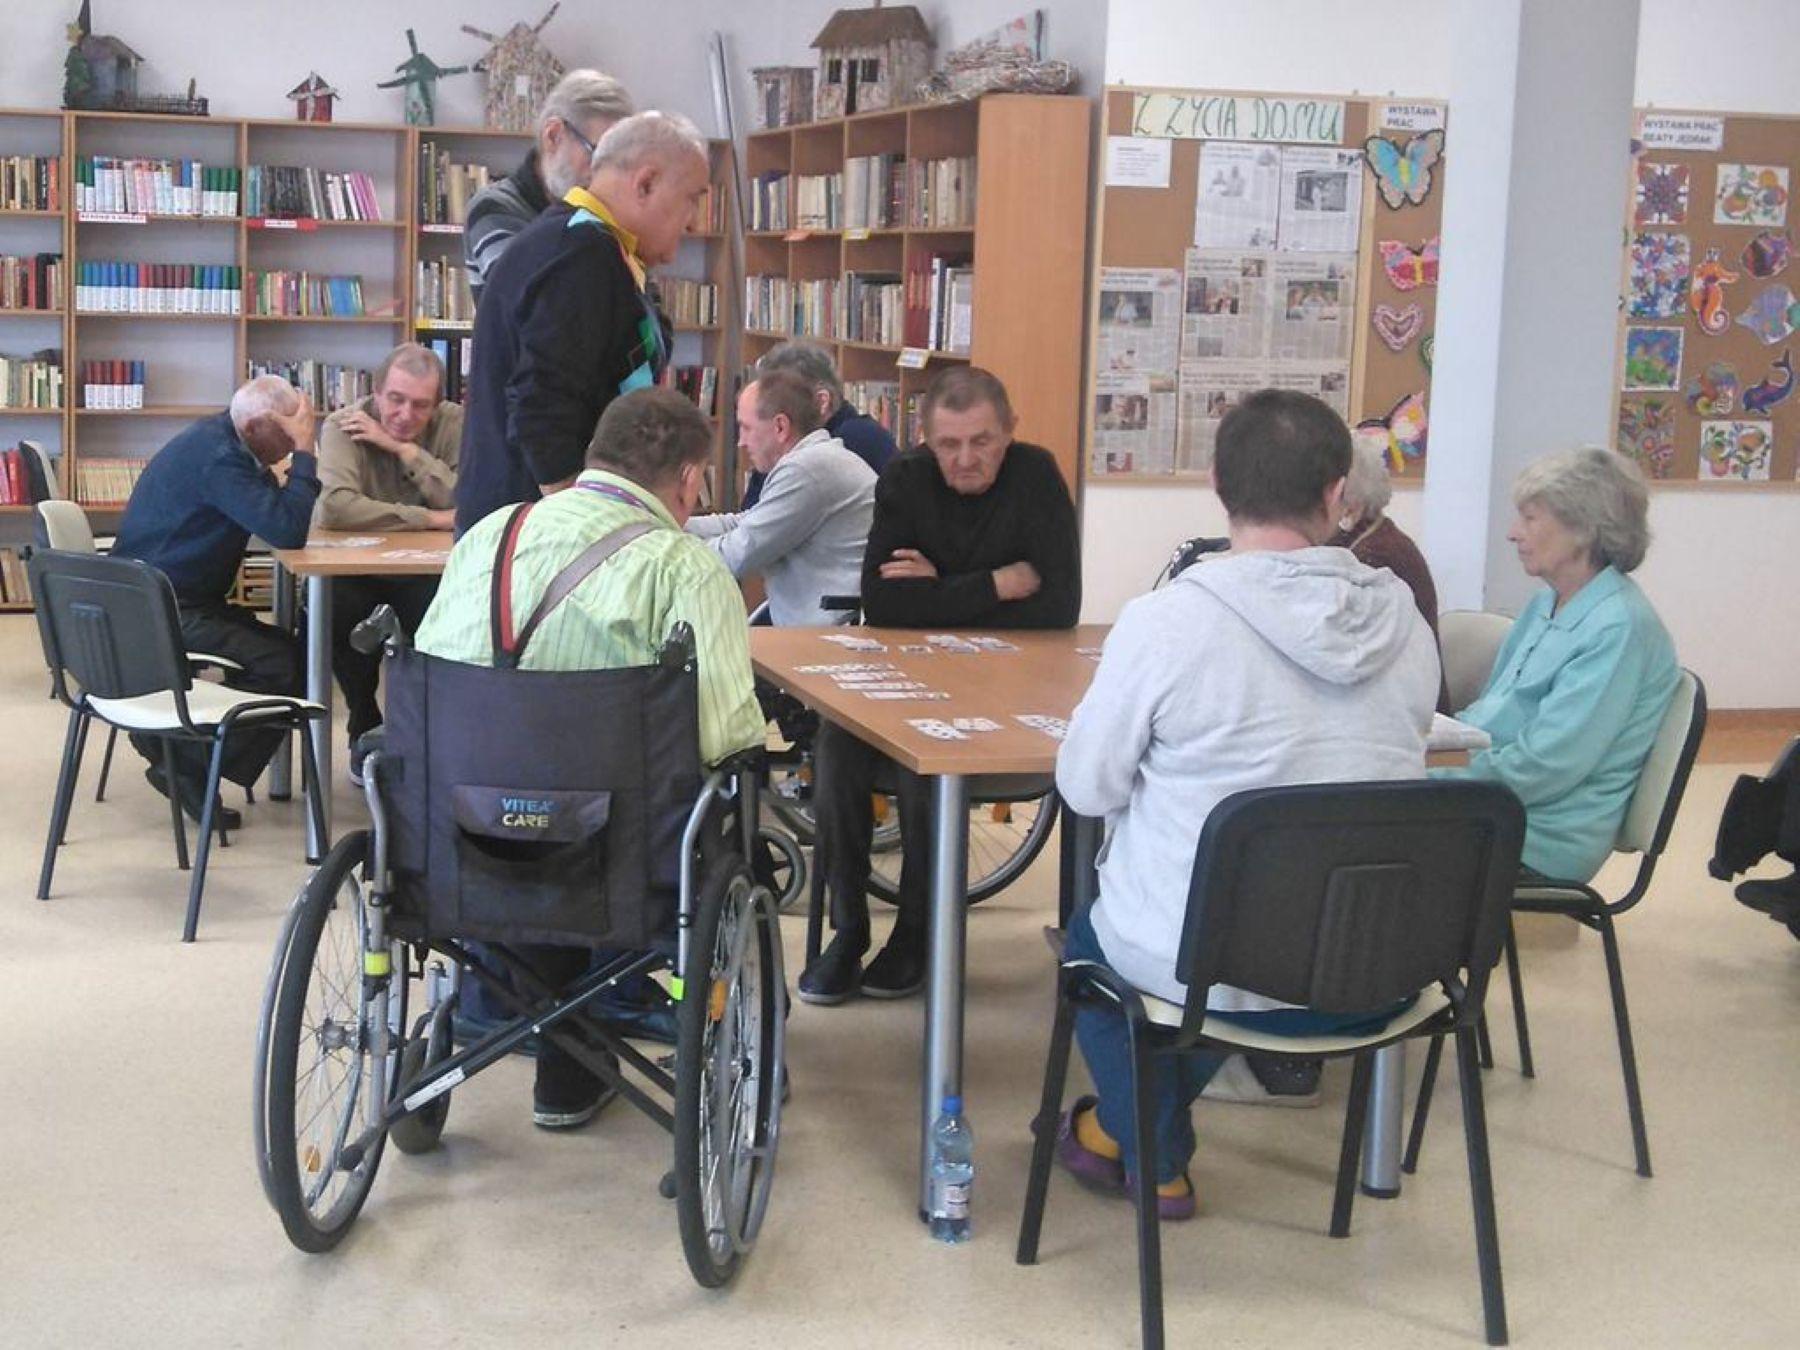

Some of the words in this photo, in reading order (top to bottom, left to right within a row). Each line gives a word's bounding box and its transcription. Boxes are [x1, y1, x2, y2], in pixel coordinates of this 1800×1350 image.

[1134, 95, 1151, 135] Z
[1251, 96, 1340, 142] DOMU
[502, 813, 549, 828] CARE
